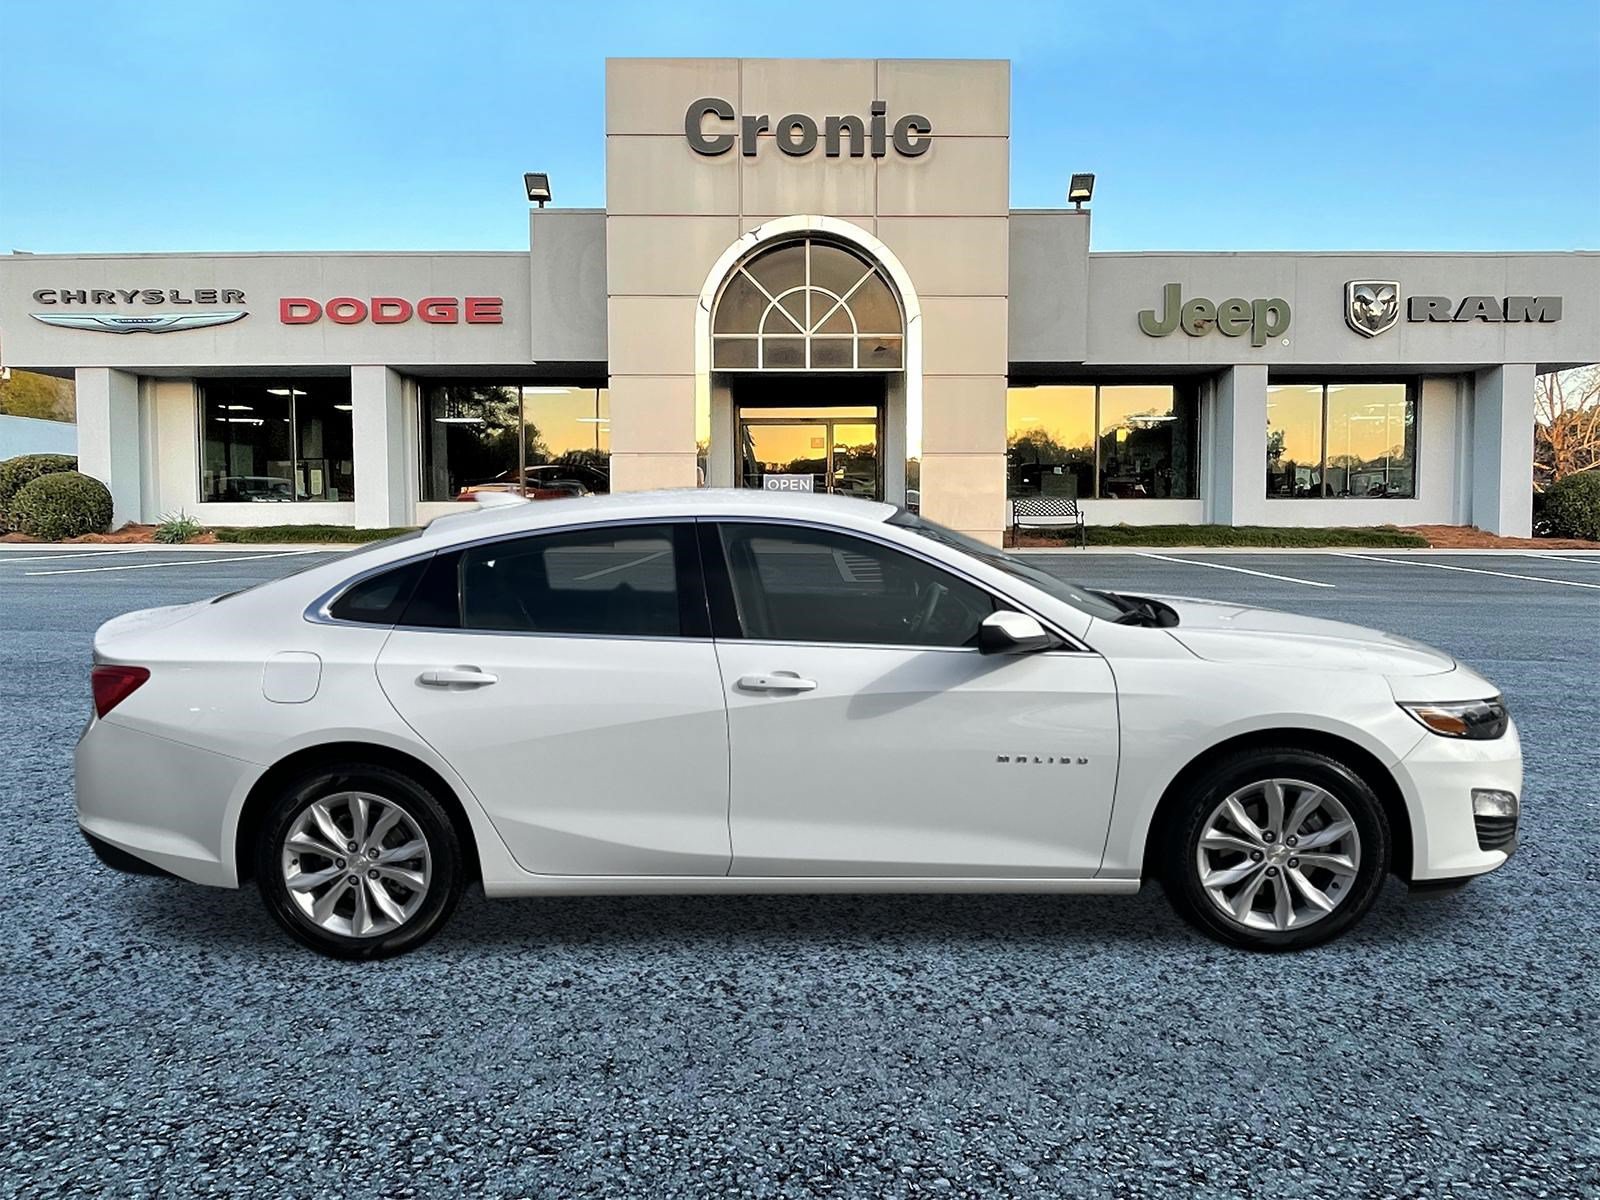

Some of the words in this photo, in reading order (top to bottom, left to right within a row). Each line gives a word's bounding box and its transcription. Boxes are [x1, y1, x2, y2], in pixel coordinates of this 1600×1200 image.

[685, 97, 932, 157] Cronic
[32, 289, 246, 304] CHRYSLER
[1407, 296, 1563, 322] RAM
[280, 297, 503, 324] DODGE
[1138, 283, 1291, 347] Jeep
[767, 479, 810, 490] OPEN
[996, 755, 1089, 765] MALIBU
